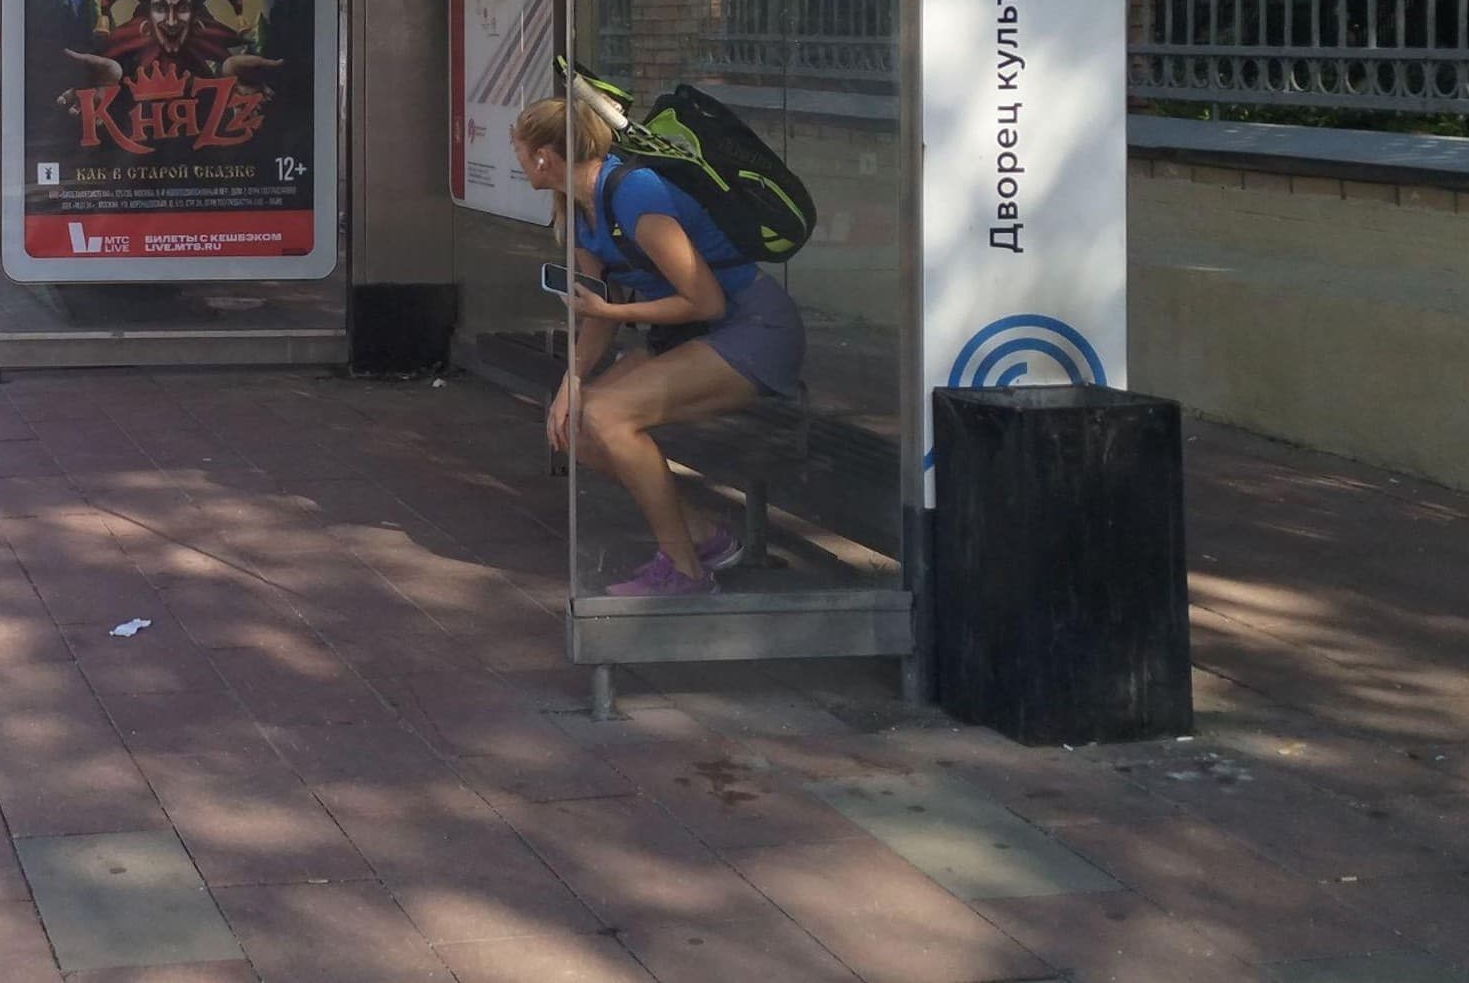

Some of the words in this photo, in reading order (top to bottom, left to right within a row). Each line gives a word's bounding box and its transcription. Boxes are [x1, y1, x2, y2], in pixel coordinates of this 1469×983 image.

[76, 167, 107, 181] КАК
[113, 168, 121, 180] В
[127, 165, 188, 179] СТАРОЙ
[193, 166, 256, 178] СКАЗКЕ
[275, 156, 307, 181] 12+
[989, 102, 1026, 255] Дворец
[104, 236, 130, 245] МТС
[145, 235, 198, 244] БИЛЕТЫ
[200, 234, 209, 243] С
[210, 233, 282, 242] КЕШБЭКОМ
[104, 244, 130, 253] LIVE
[145, 243, 222, 252] LIVE.MTS.RU
